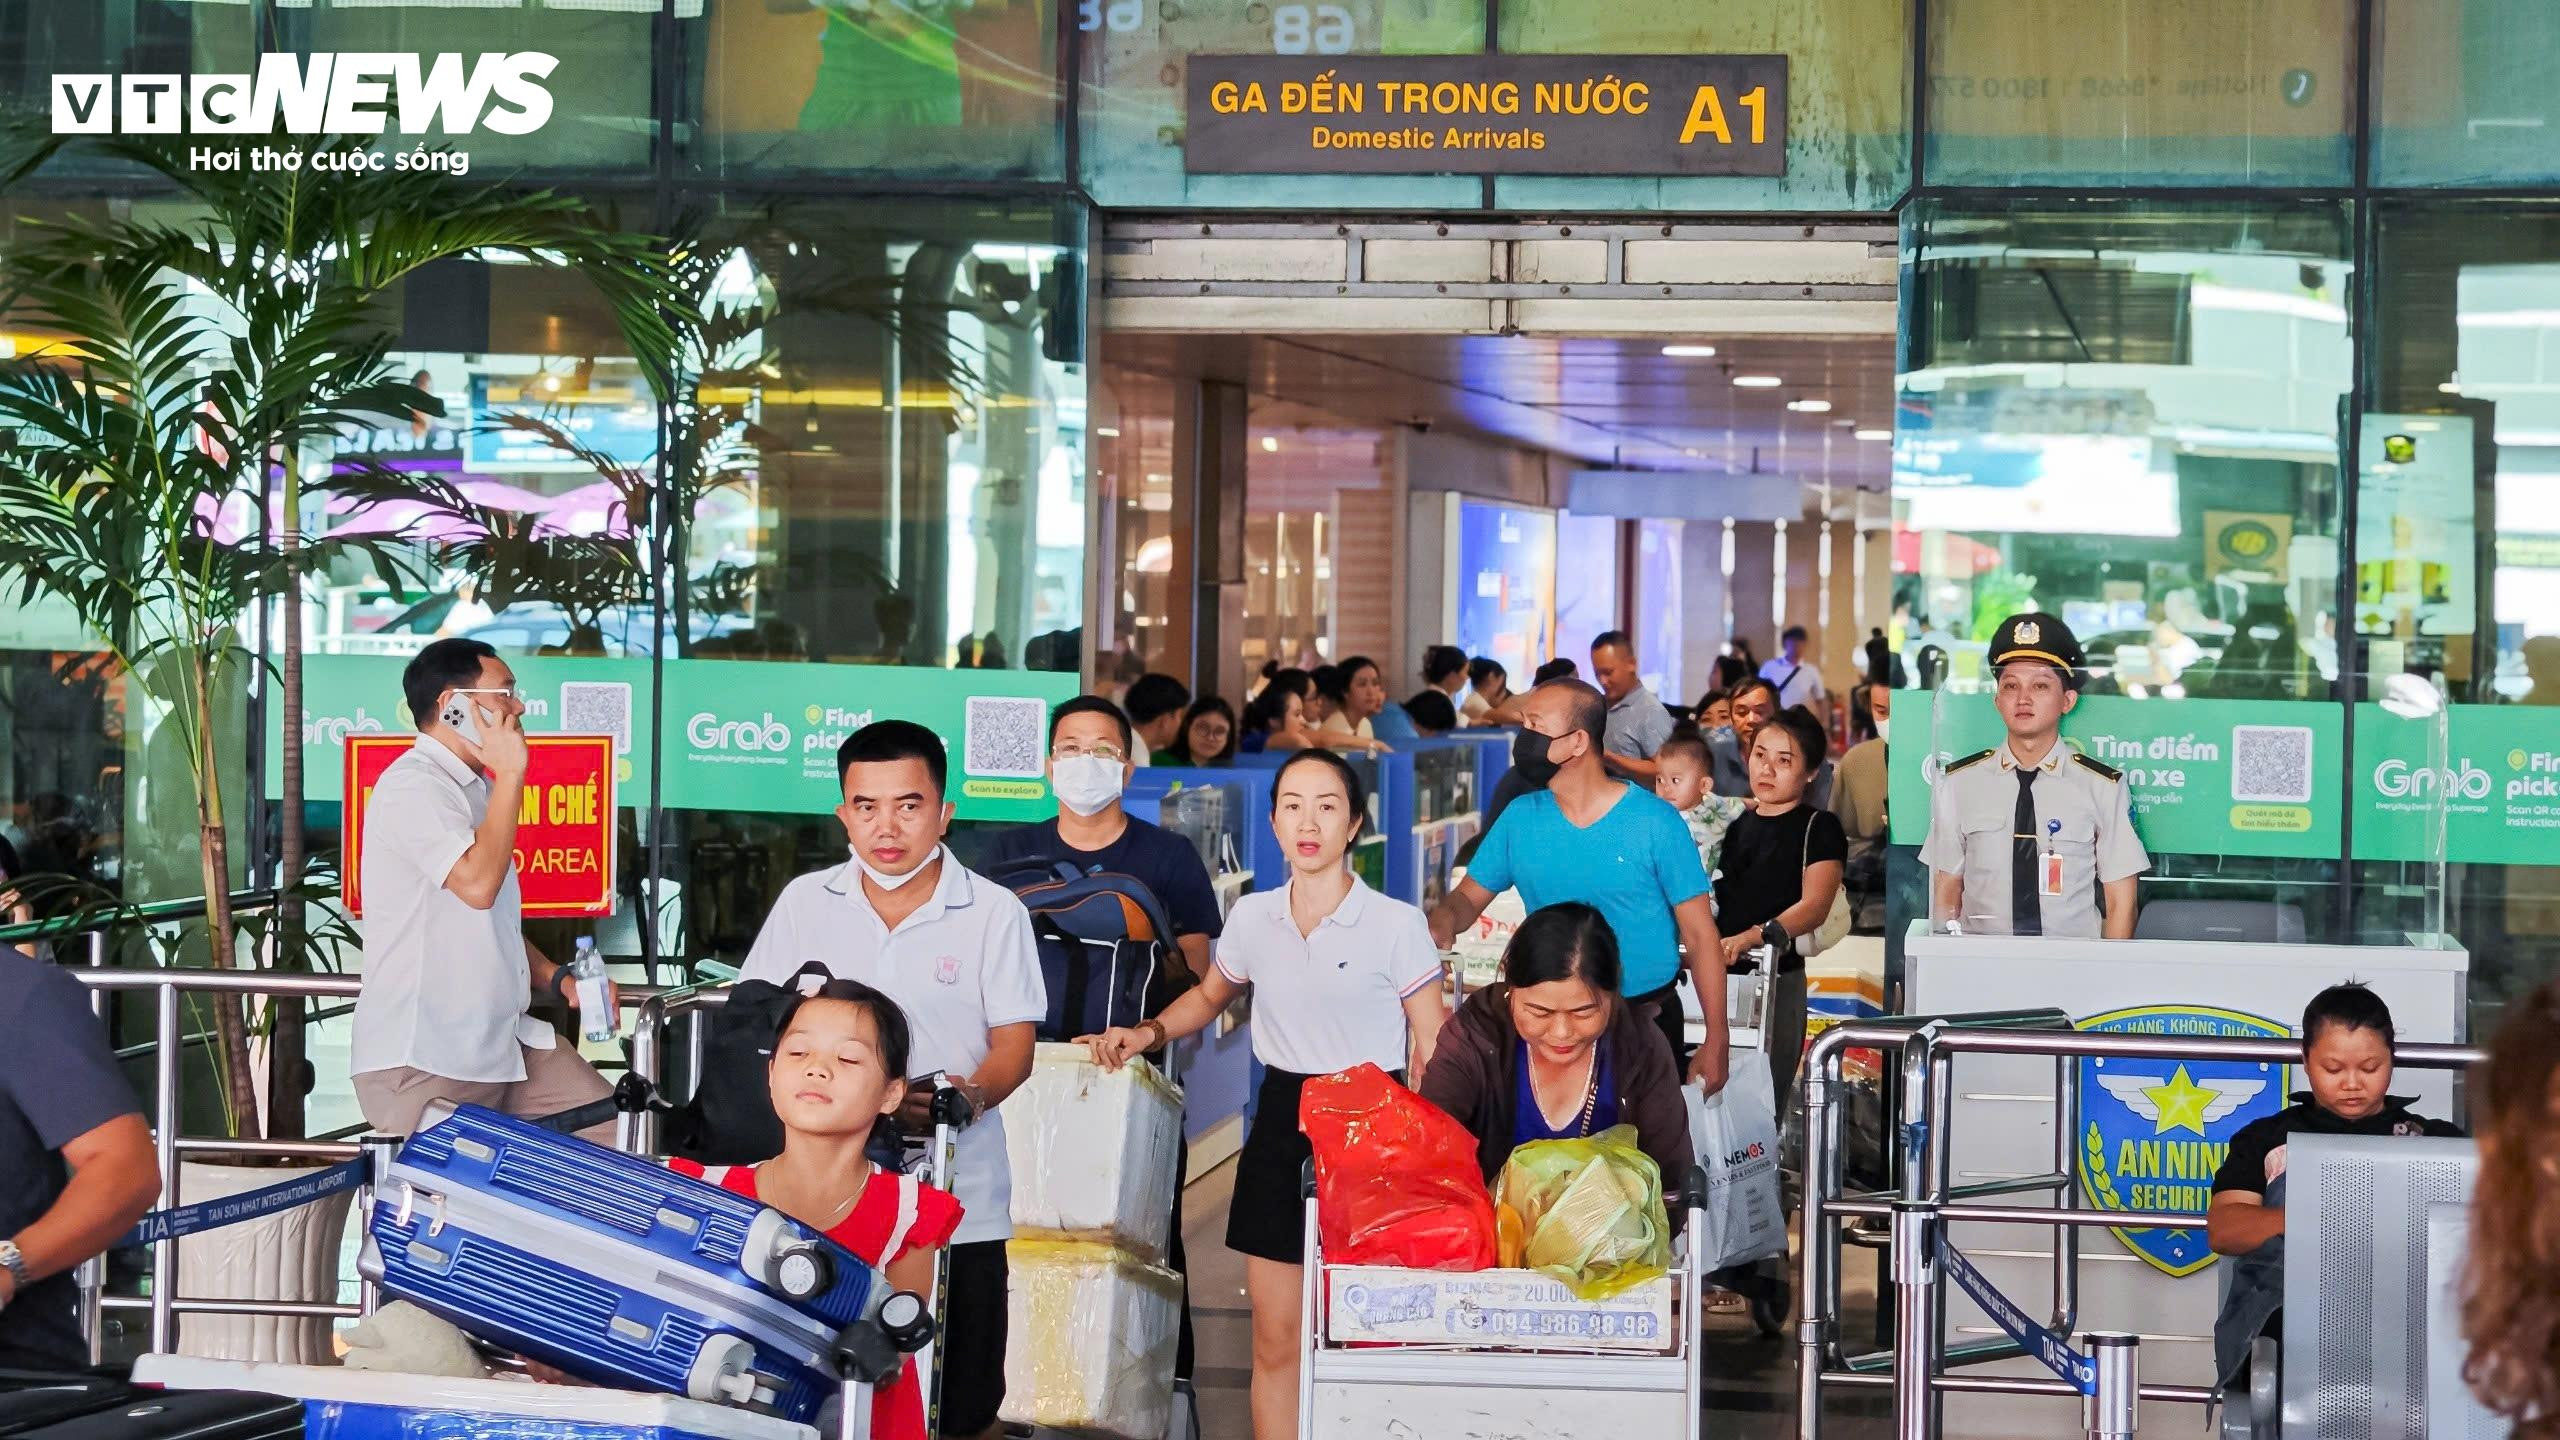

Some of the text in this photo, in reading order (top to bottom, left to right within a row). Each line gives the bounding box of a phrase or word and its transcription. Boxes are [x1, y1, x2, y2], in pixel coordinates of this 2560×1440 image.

[1210, 69, 1650, 115] GA ĐẾN TRONG NƯỚC
[1679, 86, 1767, 144] A1
[1312, 127, 1545, 150] Domestic Arrivals
[825, 708, 872, 728] Find
[687, 712, 791, 752] Grab
[2091, 734, 2219, 761] Tìm điểm
[2151, 769, 2185, 788] xe
[548, 771, 598, 826] CHẾ
[2506, 805, 2532, 814] Scan
[2533, 806, 2549, 815] QR
[530, 848, 598, 874] AREA
[2170, 1016, 2217, 1035] KHÔNG
[1723, 1141, 1765, 1168] MEMOS
[2116, 1138, 2160, 1179] AN
[207, 1208, 223, 1222] TAN
[223, 1204, 241, 1219] SON
[240, 1199, 261, 1216] NHAT
[260, 1184, 317, 1210] INTERNATIONAL
[317, 1170, 347, 1192] AIRPORT
[2130, 1184, 2213, 1211] SECURIT
[137, 1215, 169, 1241] TIA
